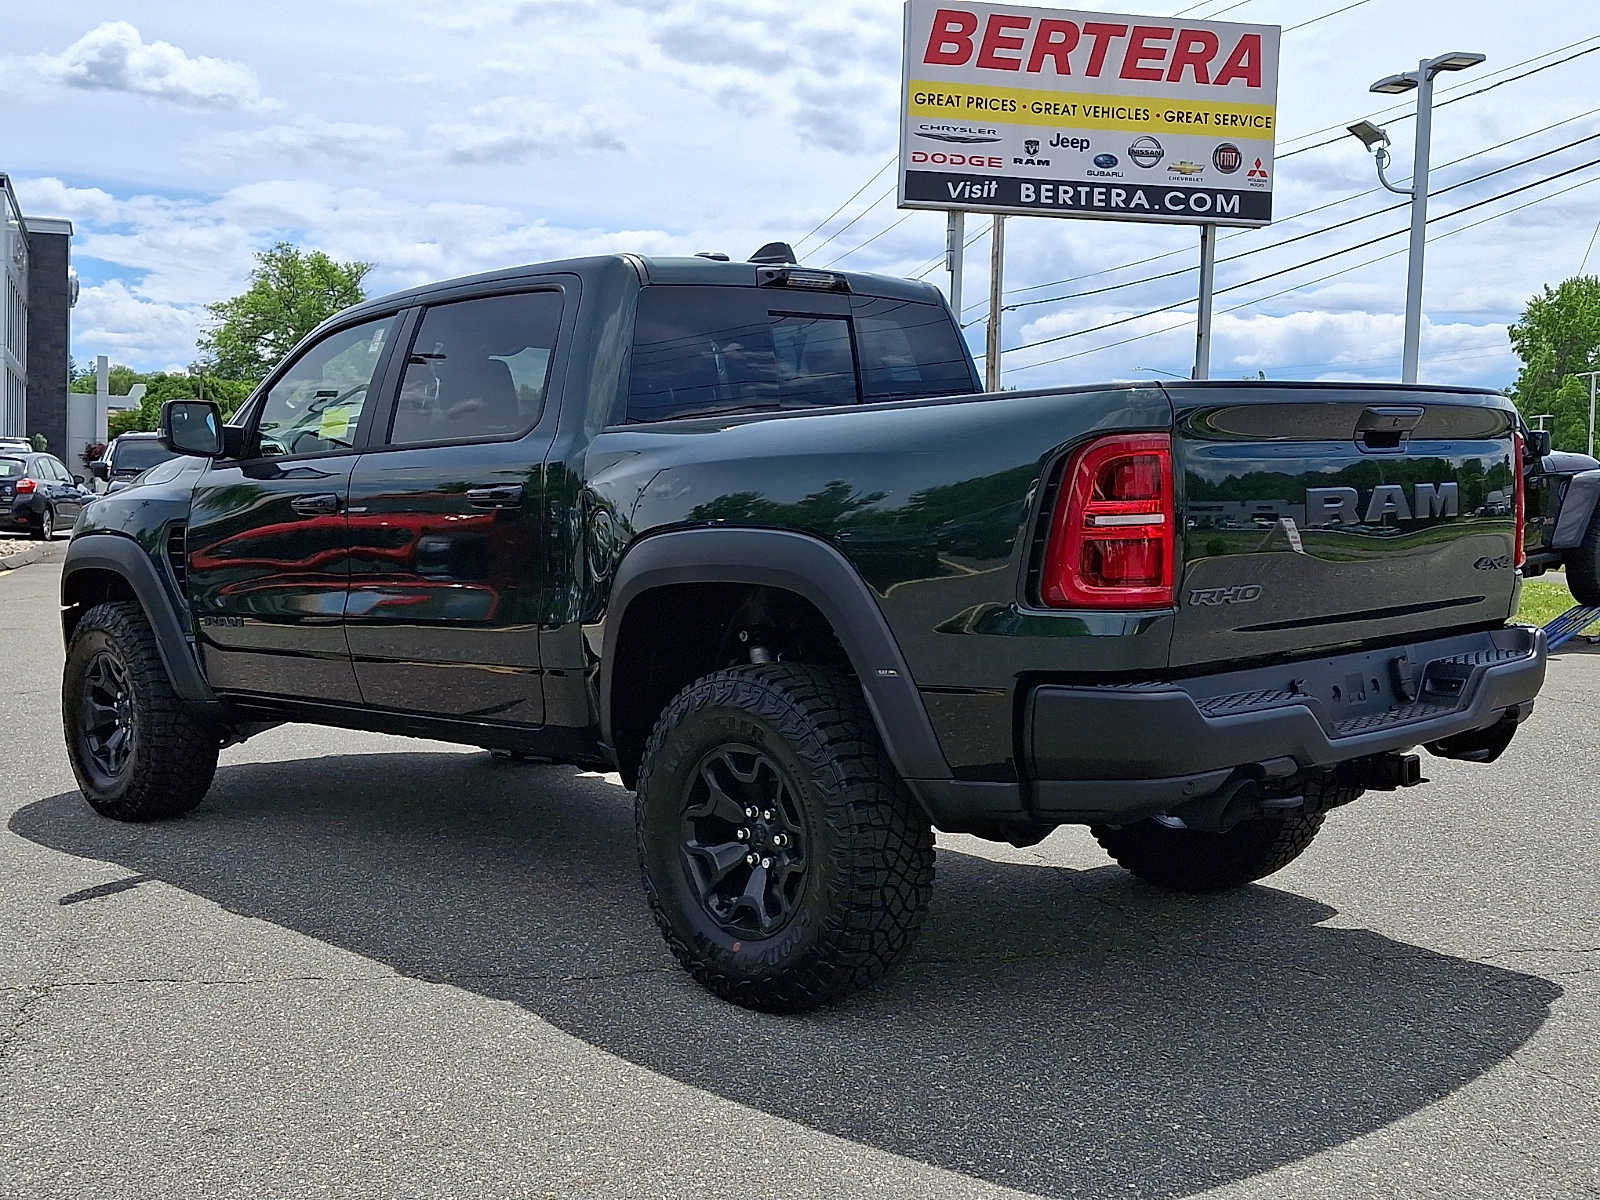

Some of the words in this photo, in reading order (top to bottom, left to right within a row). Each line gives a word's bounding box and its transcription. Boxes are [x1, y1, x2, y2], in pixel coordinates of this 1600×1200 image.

[922, 9, 1263, 88] BERTERA
[914, 92, 962, 108] GREAT
[966, 96, 1017, 112] PRICES
[1031, 101, 1078, 117] GREAT
[1083, 105, 1150, 121] VEHICLES
[1164, 110, 1210, 125] GREAT
[1214, 113, 1272, 129] SERVICE
[919, 124, 997, 136] CHRYSLER
[1049, 132, 1090, 152] Jeep
[911, 151, 1003, 169] DODGE
[1013, 157, 1051, 167] RAM
[1131, 148, 1162, 157] NISSAN
[1219, 152, 1236, 167] FIAT
[1086, 169, 1124, 178] SUBARU
[947, 181, 999, 200] Visit
[1020, 182, 1240, 215] BERTERA.COM
[1304, 481, 1459, 526] RAM
[1188, 584, 1264, 608] RHO
